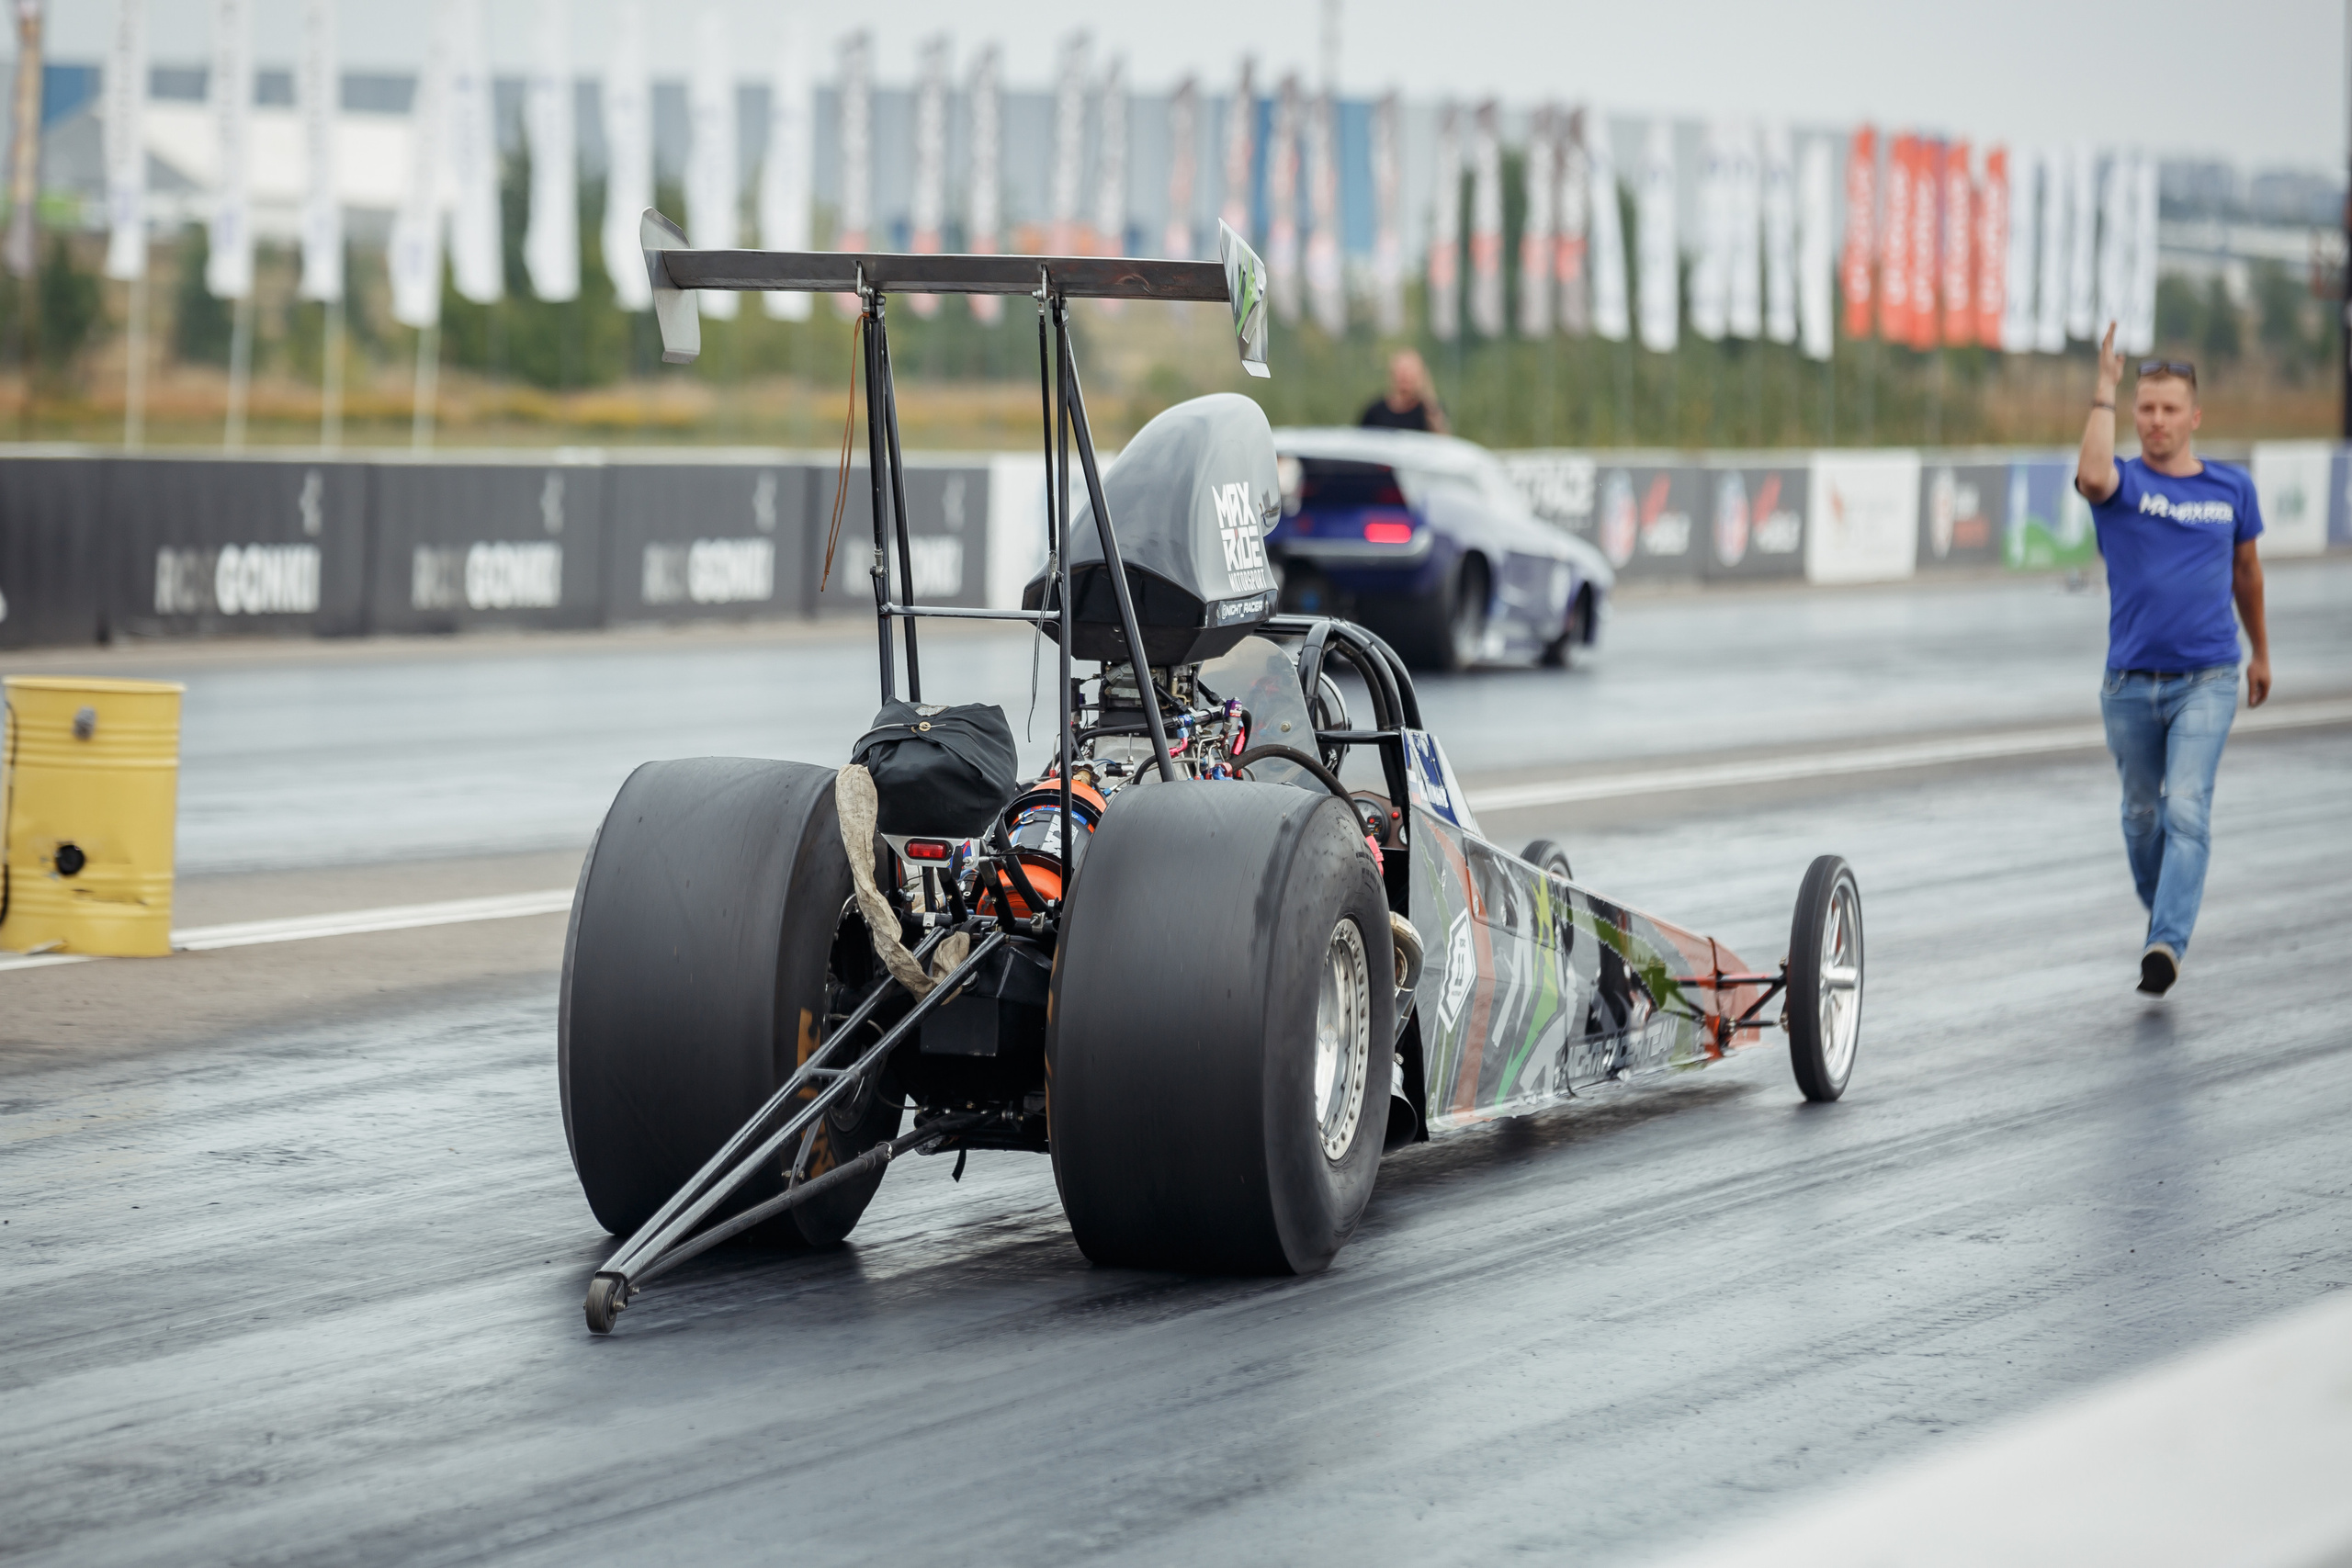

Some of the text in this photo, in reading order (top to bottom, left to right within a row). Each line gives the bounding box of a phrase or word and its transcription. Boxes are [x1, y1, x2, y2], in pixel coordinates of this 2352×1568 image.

[1212, 481, 1257, 528] MAX
[1221, 525, 1263, 571] RIDE
[1228, 569, 1267, 592] MOTORSPORT
